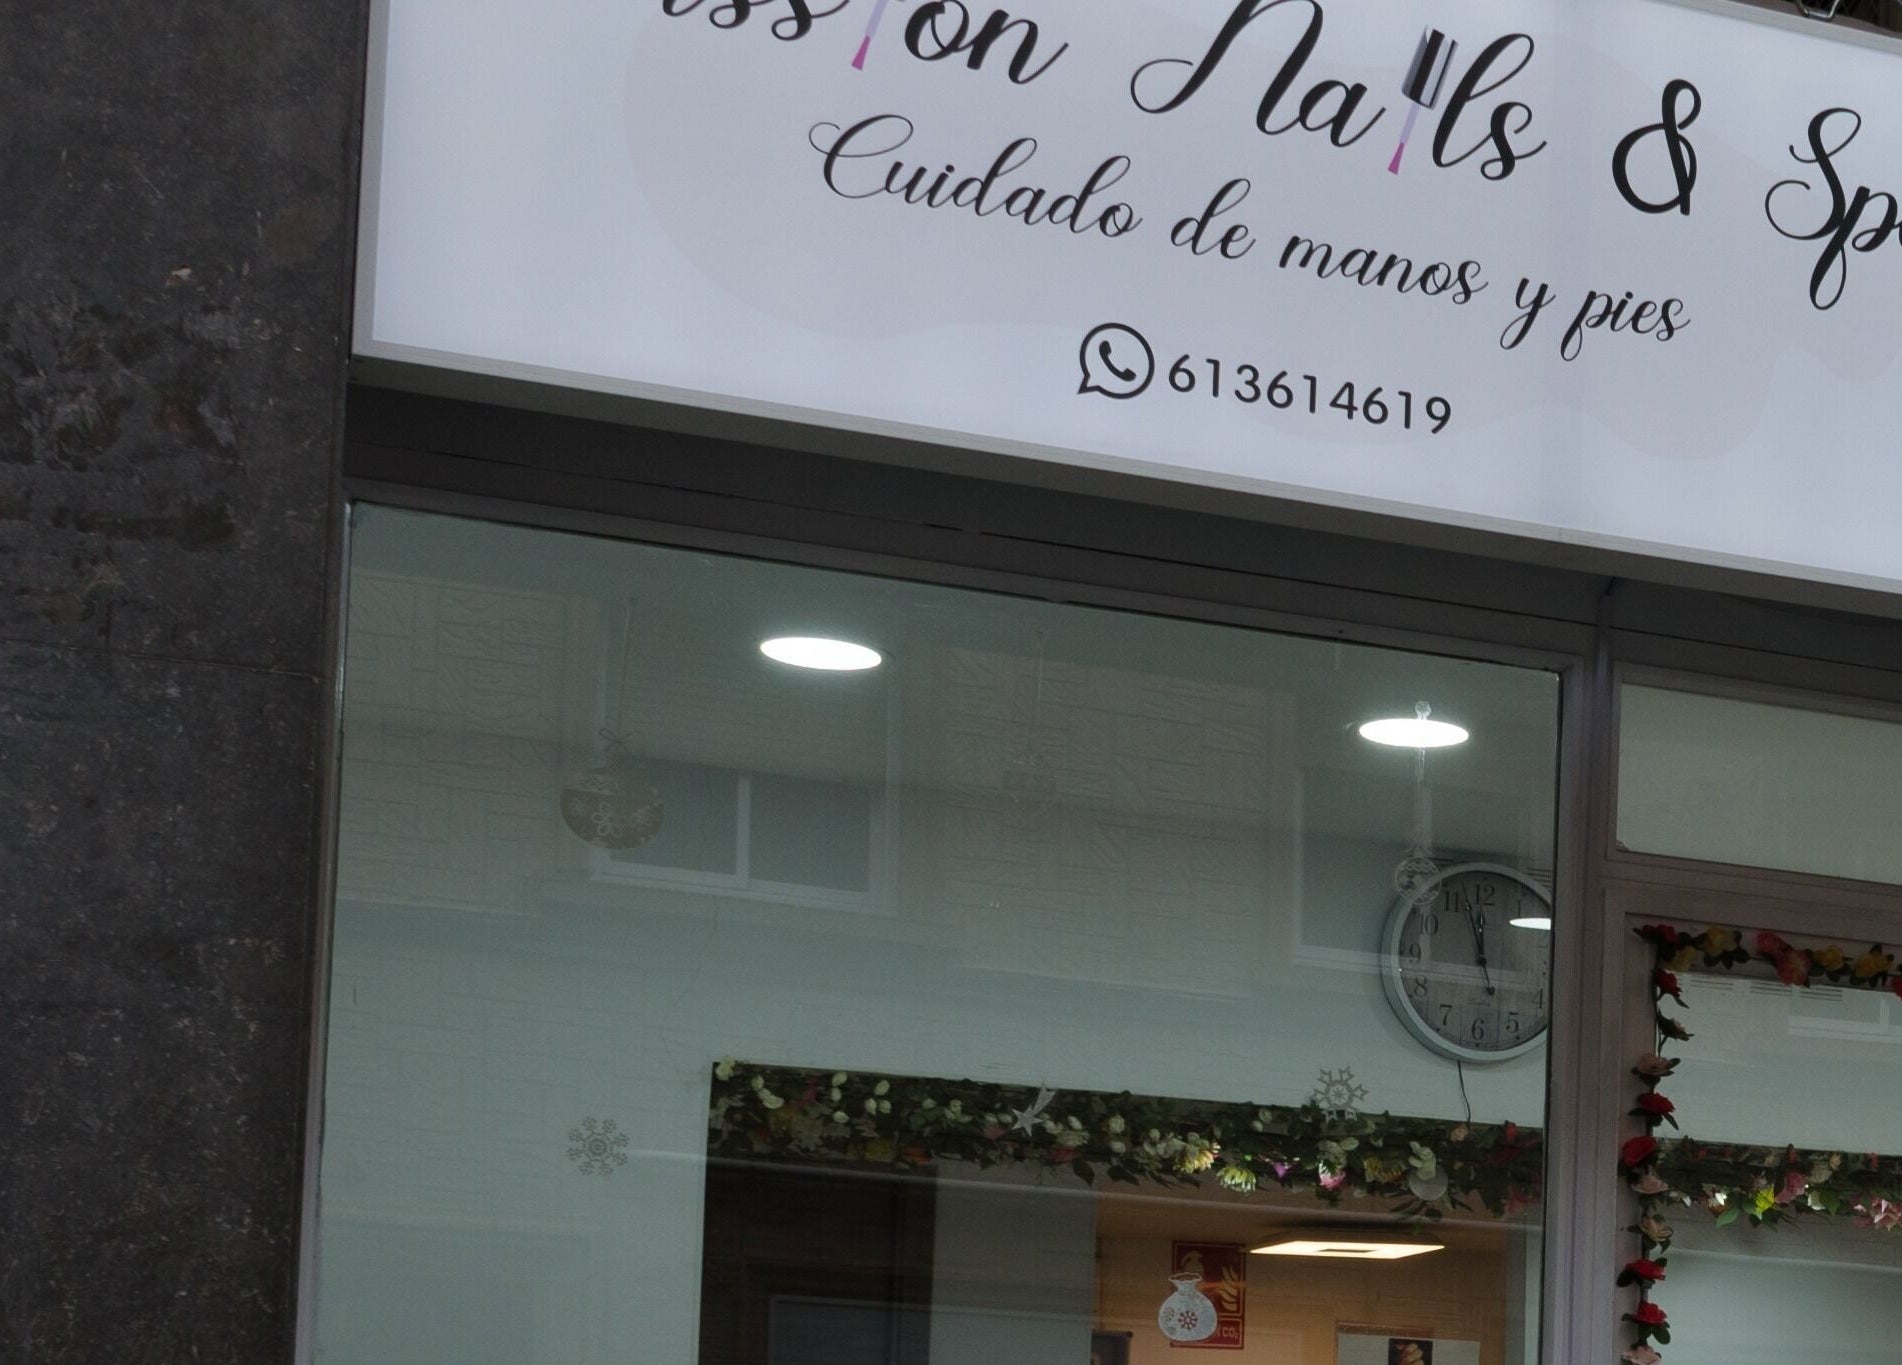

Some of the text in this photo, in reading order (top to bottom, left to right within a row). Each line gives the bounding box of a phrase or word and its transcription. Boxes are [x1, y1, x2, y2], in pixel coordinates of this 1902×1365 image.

[1612, 79, 1702, 217] &
[809, 114, 1691, 362] Cuidado de manos y pies
[1167, 352, 1453, 436] 613614619
